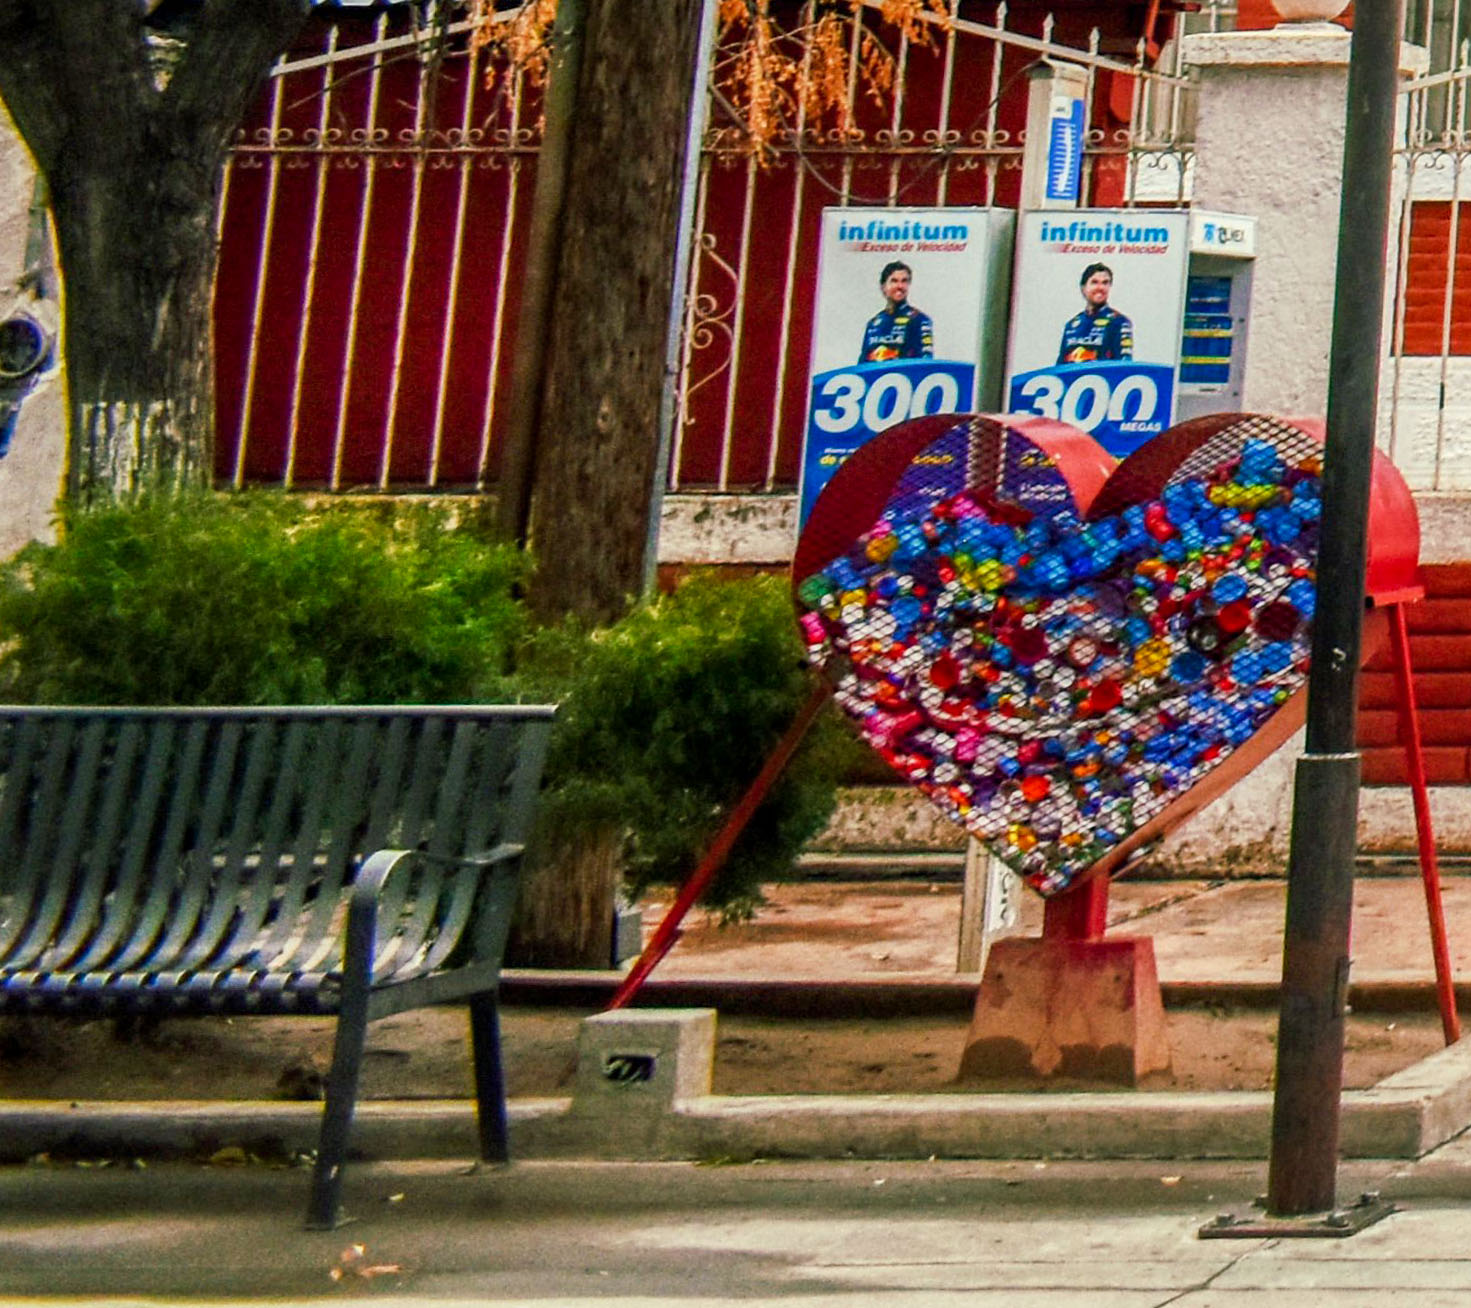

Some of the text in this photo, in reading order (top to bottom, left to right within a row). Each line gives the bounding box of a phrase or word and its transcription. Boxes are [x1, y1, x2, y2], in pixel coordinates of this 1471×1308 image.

[839, 220, 968, 241] infinitum
[1041, 221, 1169, 242] infinitum
[861, 241, 968, 252] Exceso de Velocidad
[1062, 243, 1170, 254] Exceso de Velocidad
[814, 372, 959, 433] 300
[1014, 374, 1158, 434] 300
[1120, 422, 1162, 432] MEGAS
